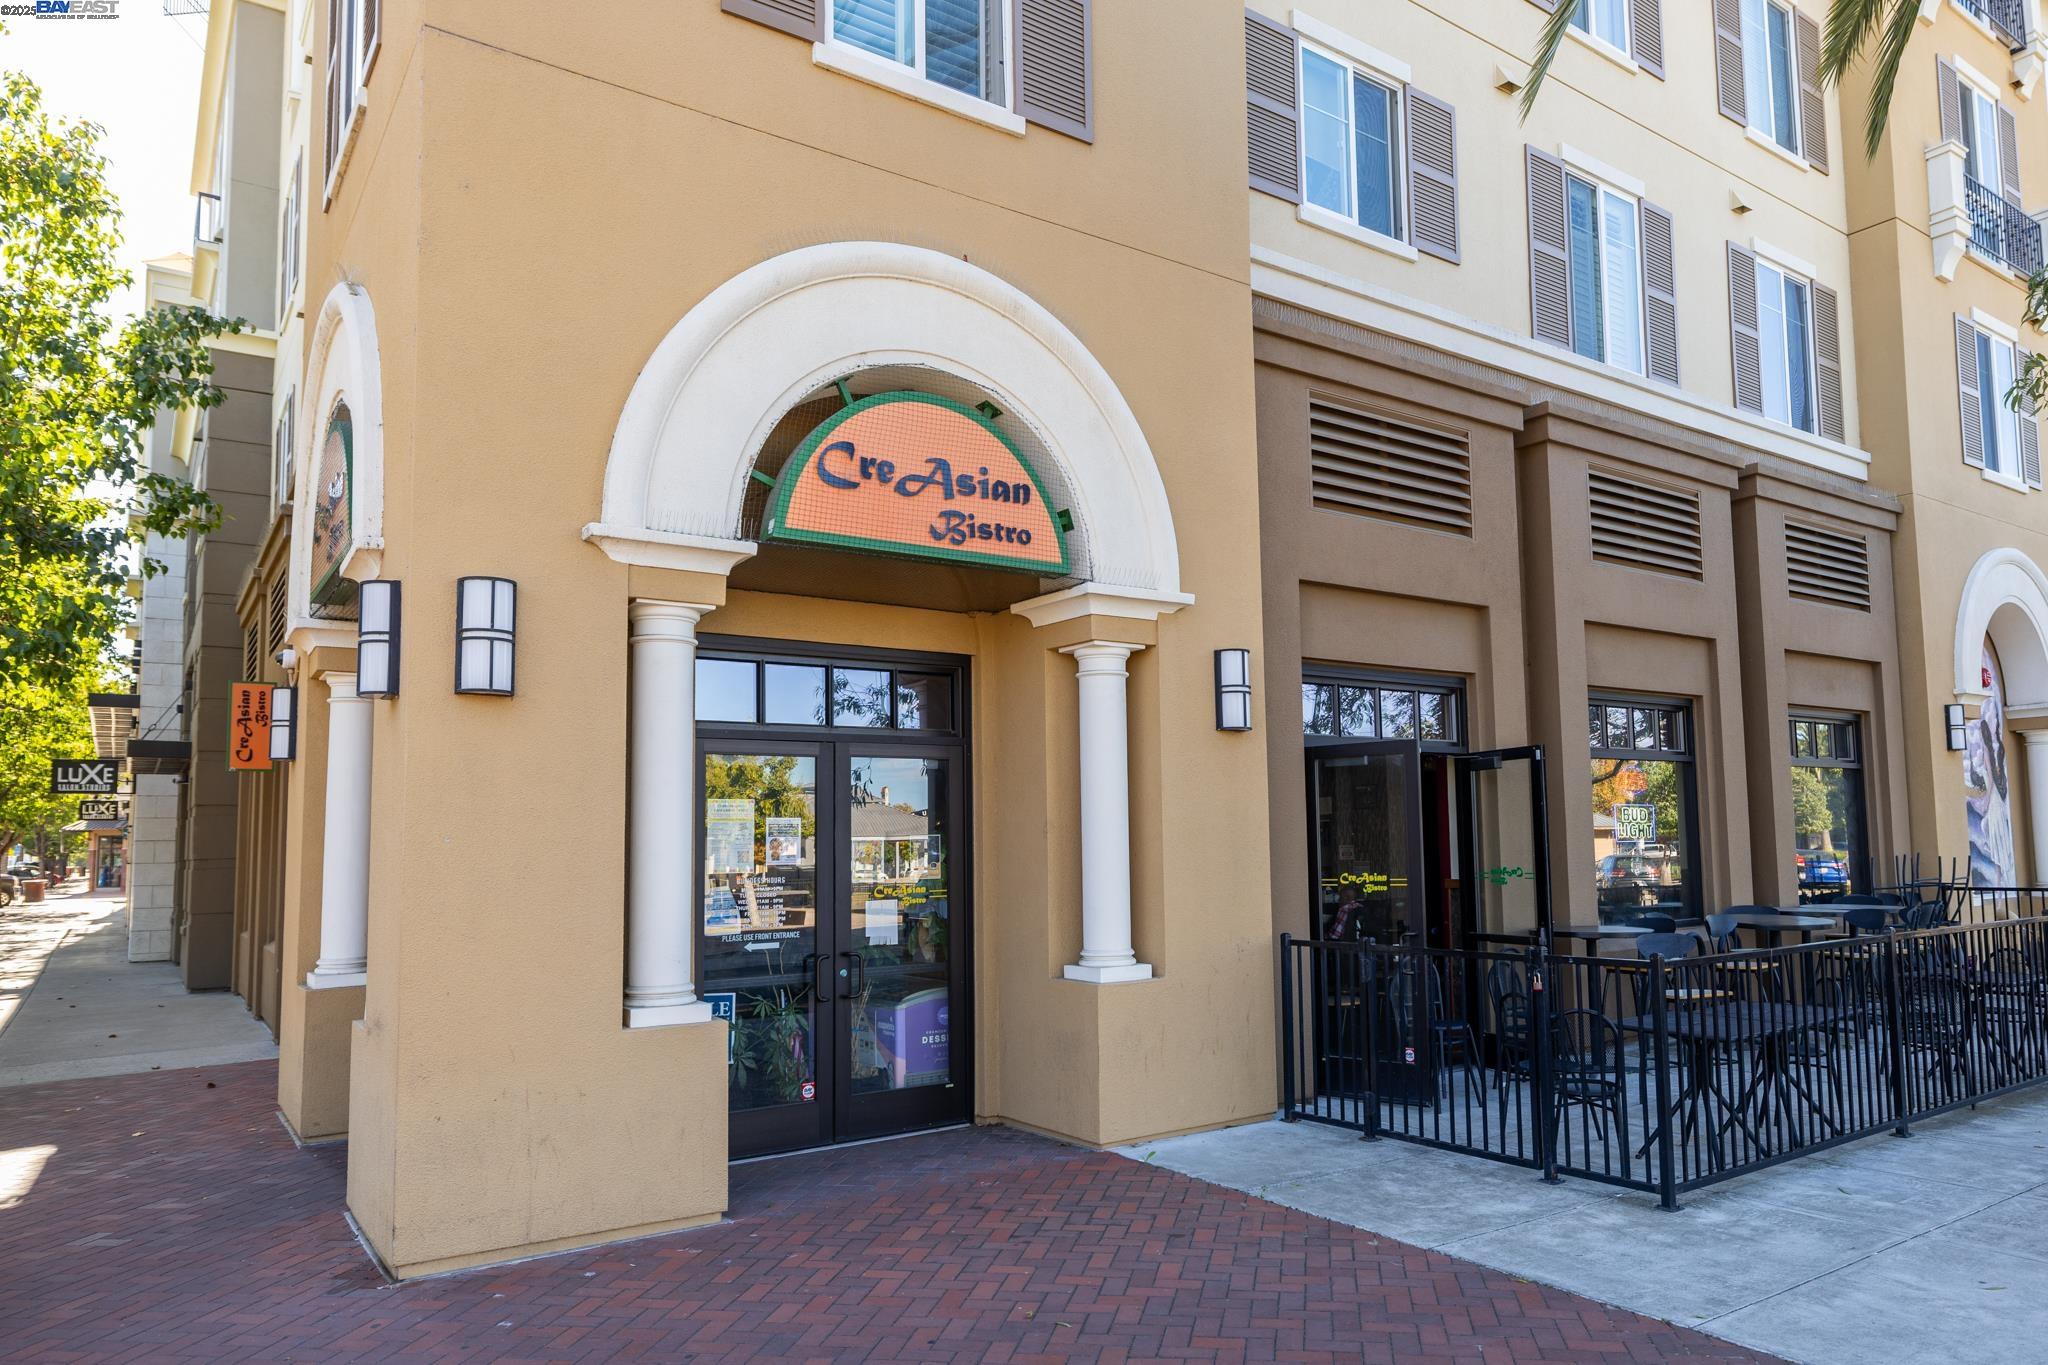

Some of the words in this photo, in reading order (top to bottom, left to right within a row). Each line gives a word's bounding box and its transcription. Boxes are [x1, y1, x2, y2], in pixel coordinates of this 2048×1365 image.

[929, 509, 1032, 546] Bistro
[255, 690, 269, 728] Bistro
[57, 763, 115, 784] LUXE
[82, 802, 117, 815] LUXE
[1621, 806, 1649, 823] BUD
[1617, 822, 1653, 839] LIGHT
[766, 876, 786, 884] HOURS
[721, 934, 743, 942] PLEASE
[744, 933, 754, 941] USE
[755, 932, 772, 941] FRONT
[773, 931, 801, 939] ENTRANCE
